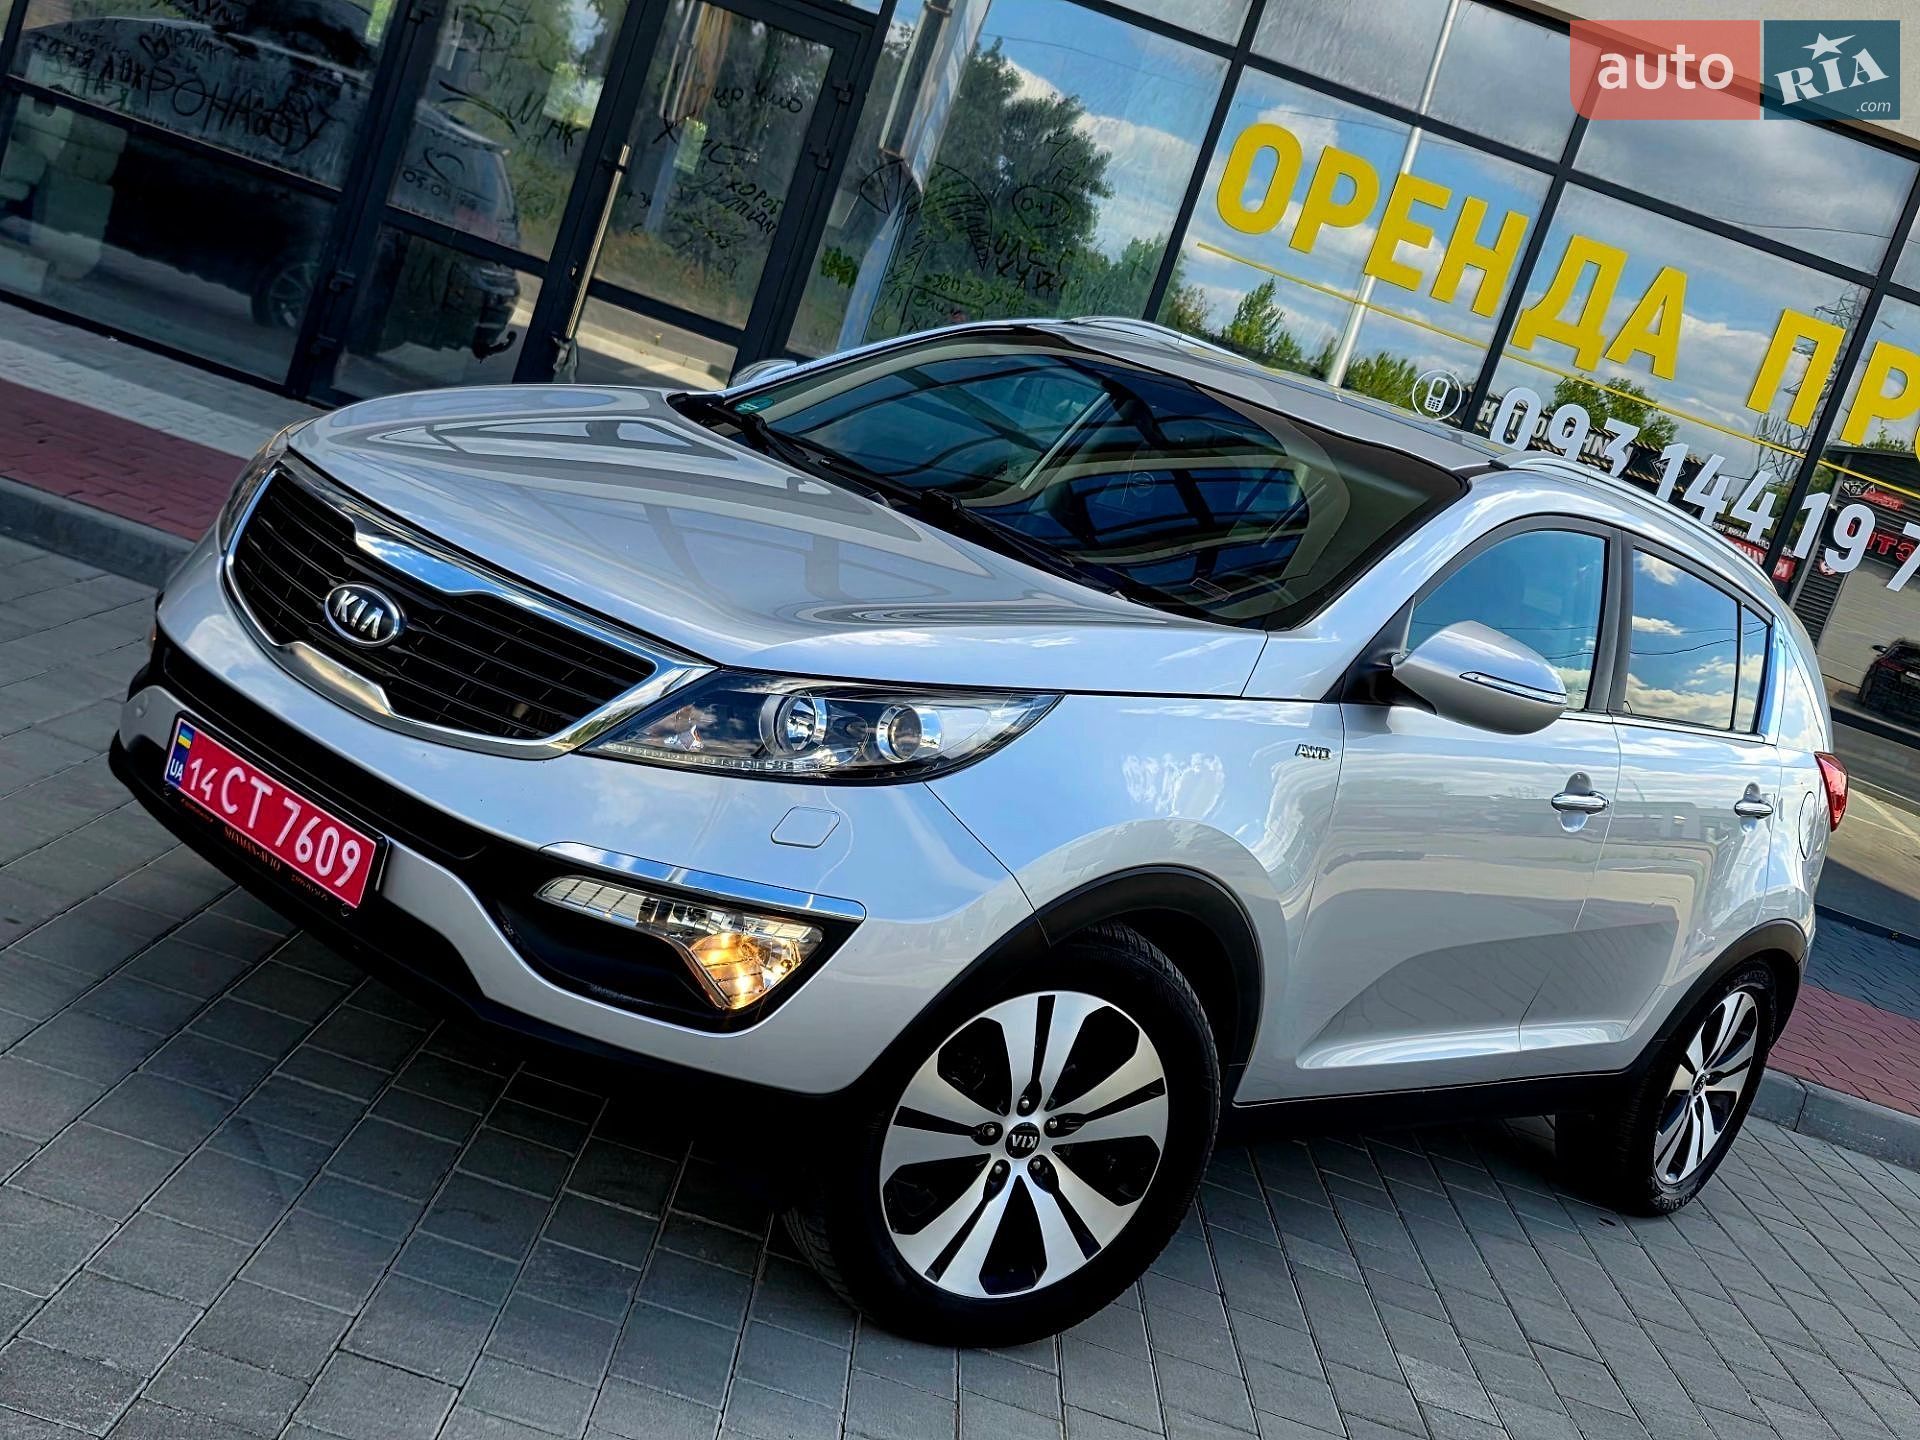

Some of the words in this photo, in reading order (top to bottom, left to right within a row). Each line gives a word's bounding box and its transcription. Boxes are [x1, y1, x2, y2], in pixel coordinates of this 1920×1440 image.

[1217, 123, 1688, 381] ОРЕНДА
[1747, 308, 1920, 467] ПР
[1490, 387, 1640, 478] 093
[333, 589, 386, 639] KIA
[170, 758, 183, 781] UA
[1295, 743, 1332, 760] AWD
[275, 796, 361, 887] 7609
[1011, 1133, 1038, 1150] KIA
